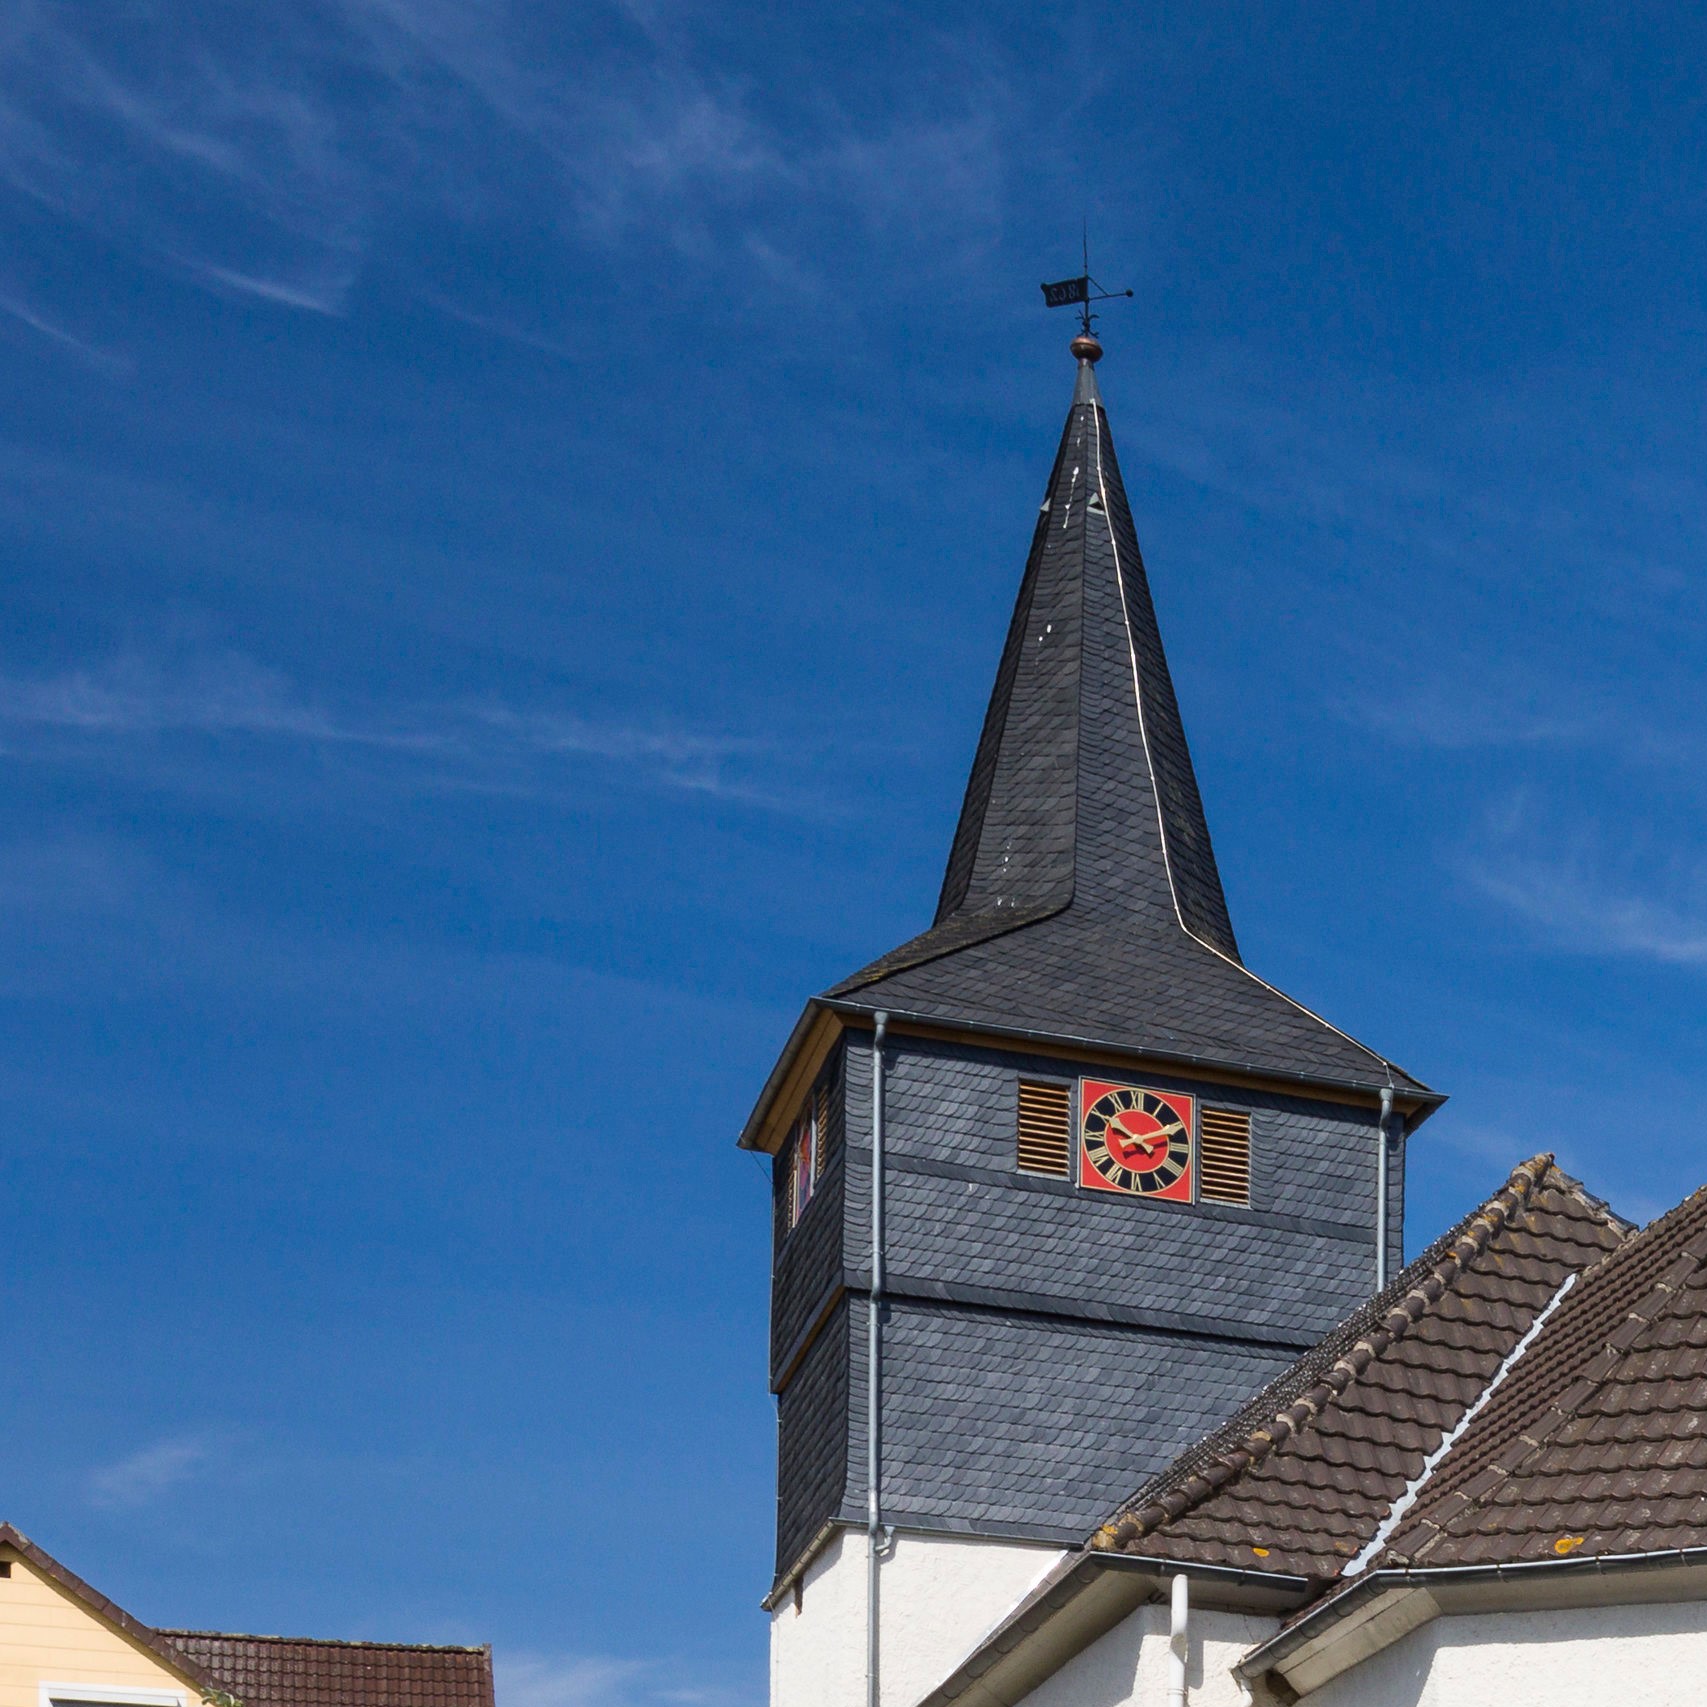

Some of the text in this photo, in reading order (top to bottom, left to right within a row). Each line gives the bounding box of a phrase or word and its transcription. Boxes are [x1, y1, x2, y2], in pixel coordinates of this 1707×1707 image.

[1107, 1092, 1125, 1114] XI
[1130, 1090, 1144, 1111] XII
[1153, 1101, 1164, 1117] I
[1084, 1129, 1104, 1142] IX
[1088, 1145, 1110, 1167] VIII
[1169, 1142, 1189, 1154] III
[1105, 1163, 1124, 1185] VII
[1131, 1172, 1142, 1192] VI
[1152, 1172, 1166, 1189] V
